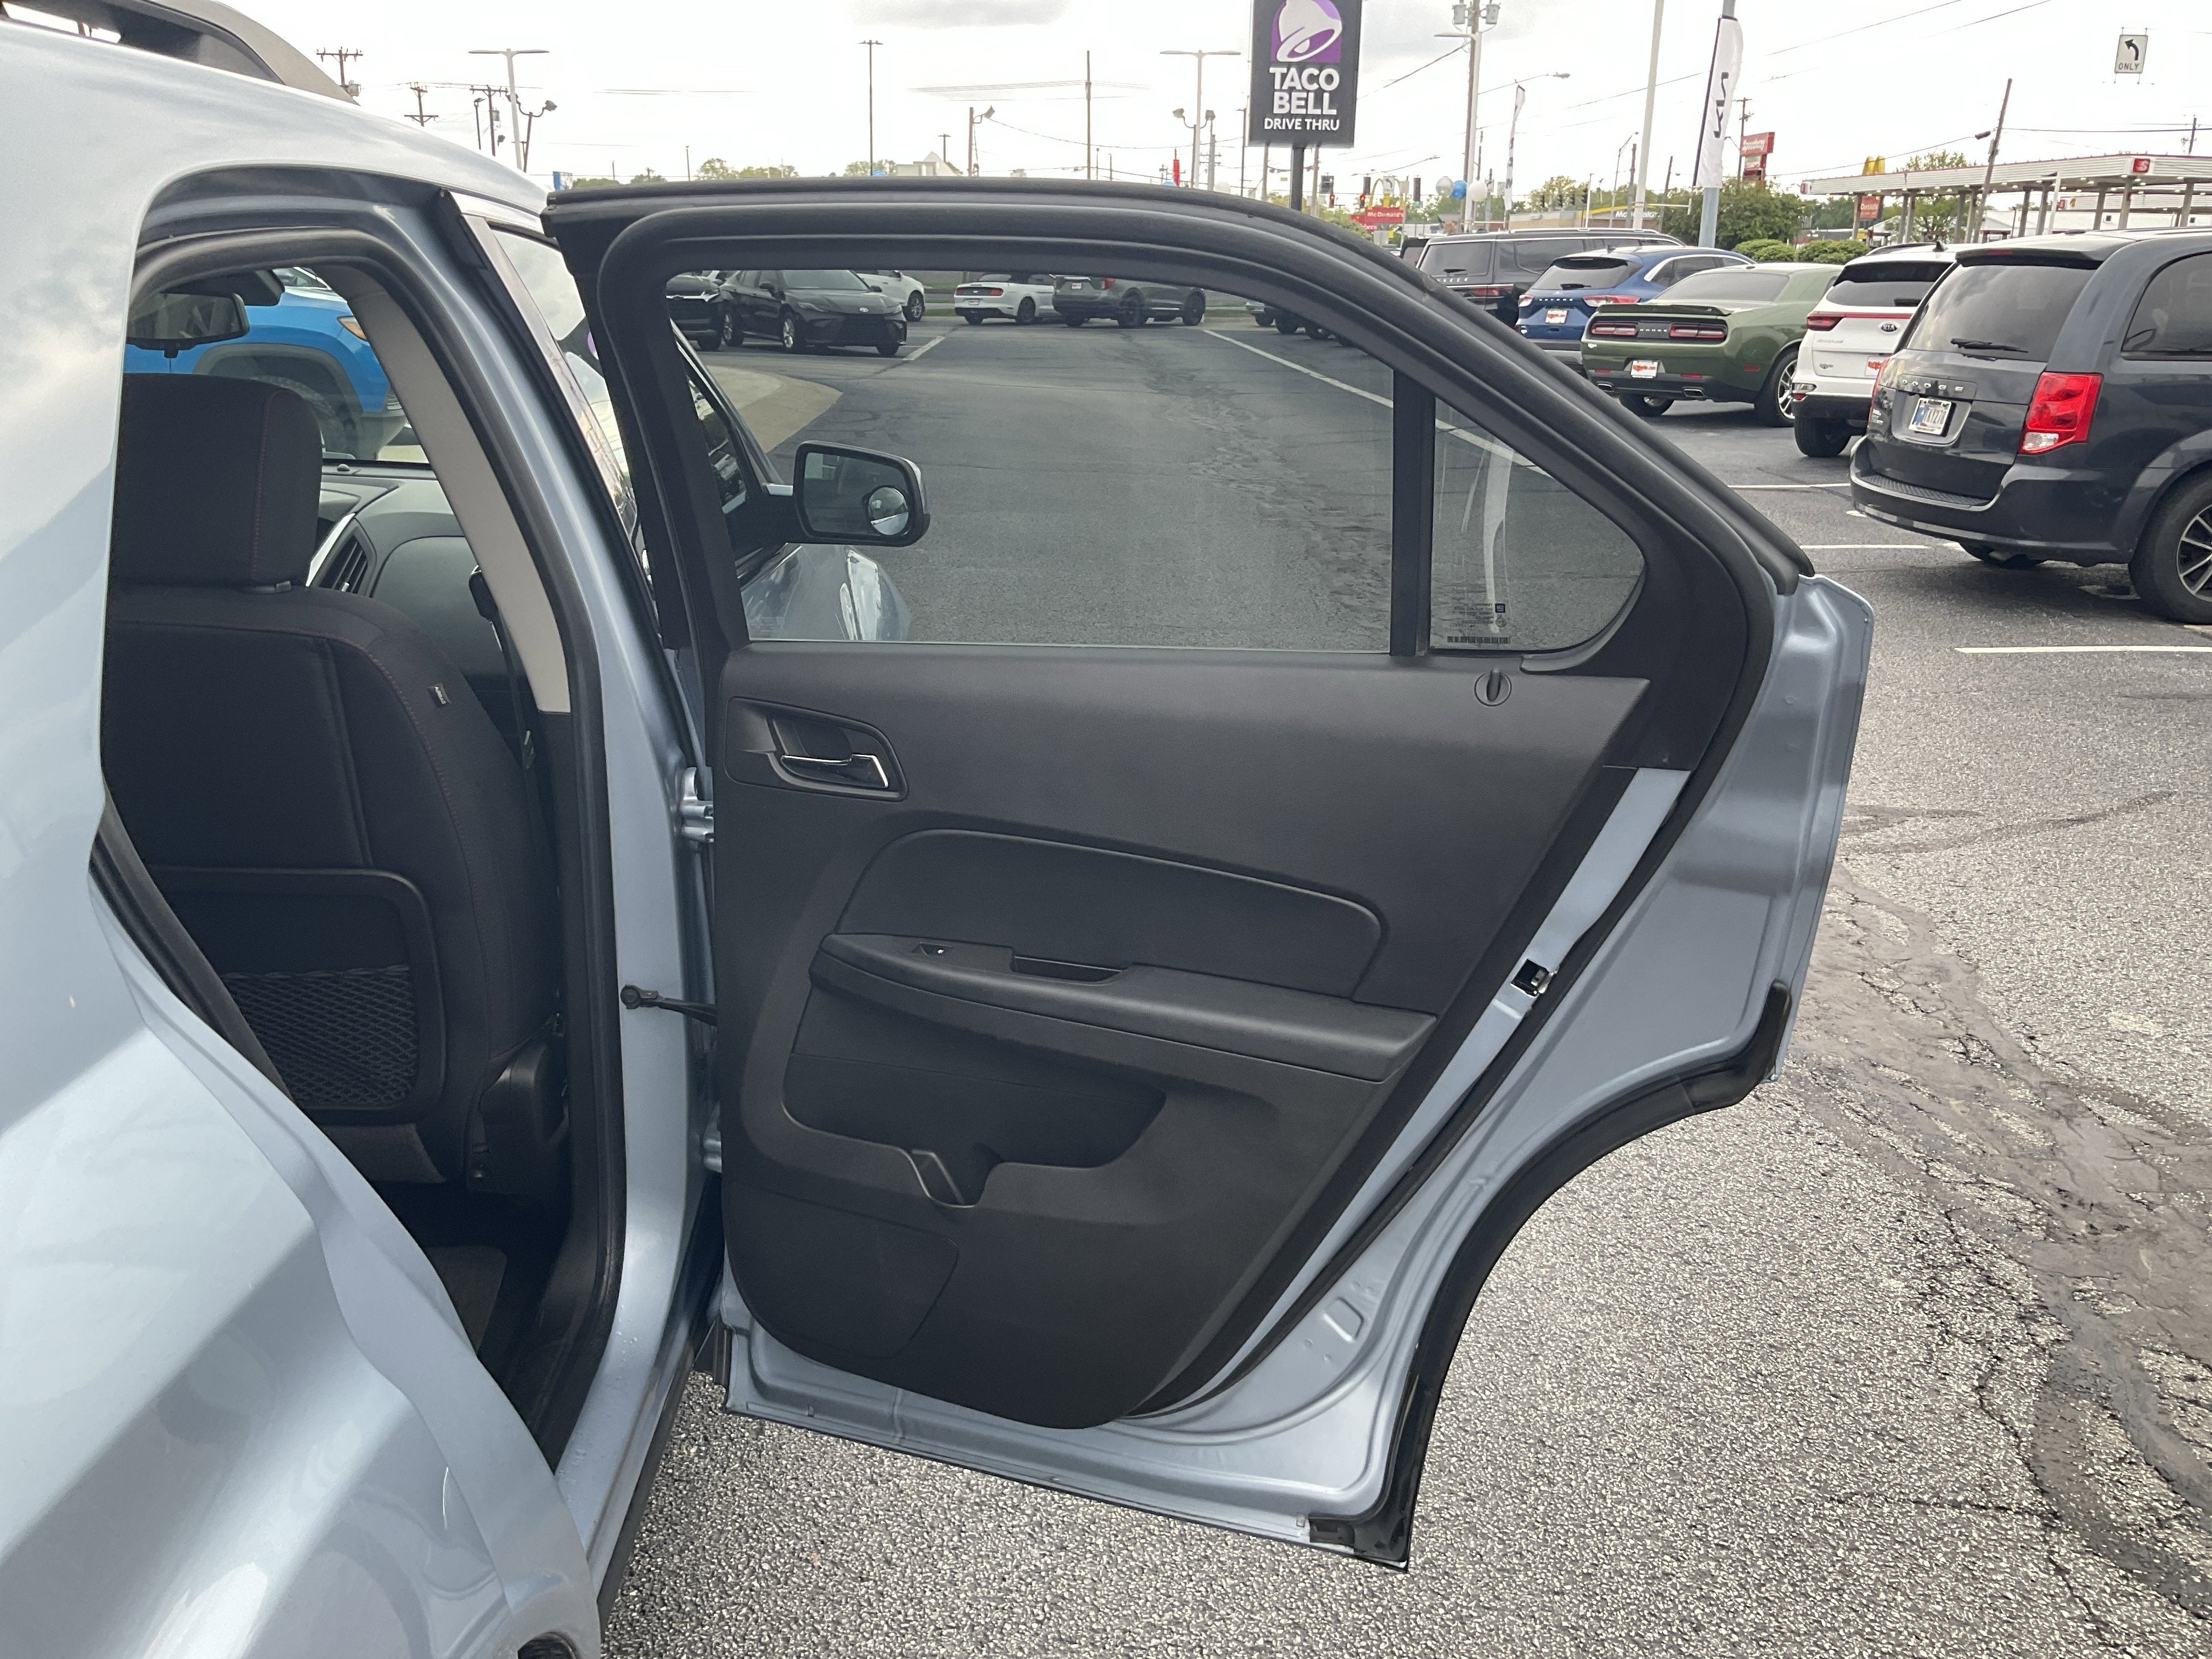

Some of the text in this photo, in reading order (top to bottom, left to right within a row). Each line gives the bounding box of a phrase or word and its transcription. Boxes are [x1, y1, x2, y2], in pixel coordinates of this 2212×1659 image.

[2118, 62, 2140, 70] ONLY
[1269, 67, 1340, 91] TACO
[1273, 92, 1337, 115] BELL
[1264, 118, 1340, 131] DRIVE THRU
[1902, 379, 1965, 392] DODGE
[435, 686, 446, 704] AIRBAG
